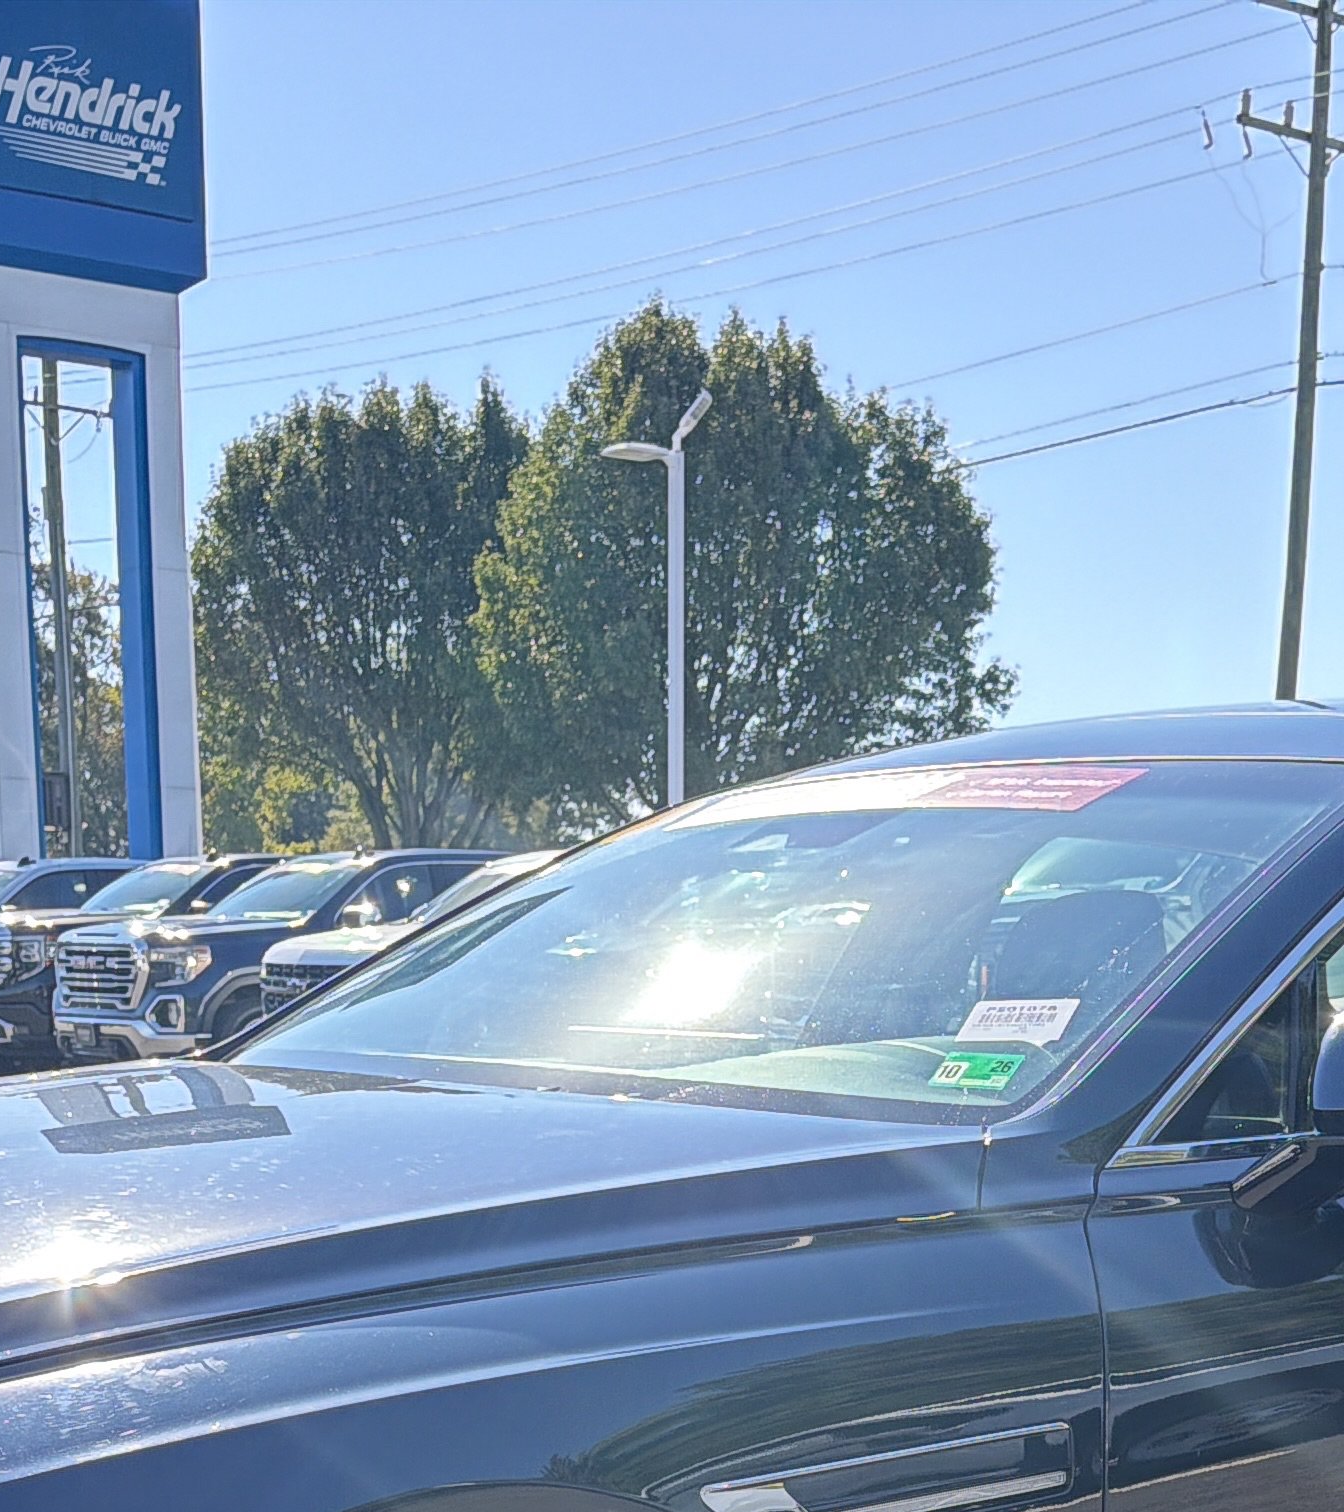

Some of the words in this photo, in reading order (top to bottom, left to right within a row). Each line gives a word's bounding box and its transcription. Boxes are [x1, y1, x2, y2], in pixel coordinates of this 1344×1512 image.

[22, 114, 97, 141] CHEVROLET
[99, 130, 137, 149] BUICK
[140, 139, 170, 155] GMC
[938, 1064, 963, 1079] 10
[990, 1060, 1014, 1073] 26
